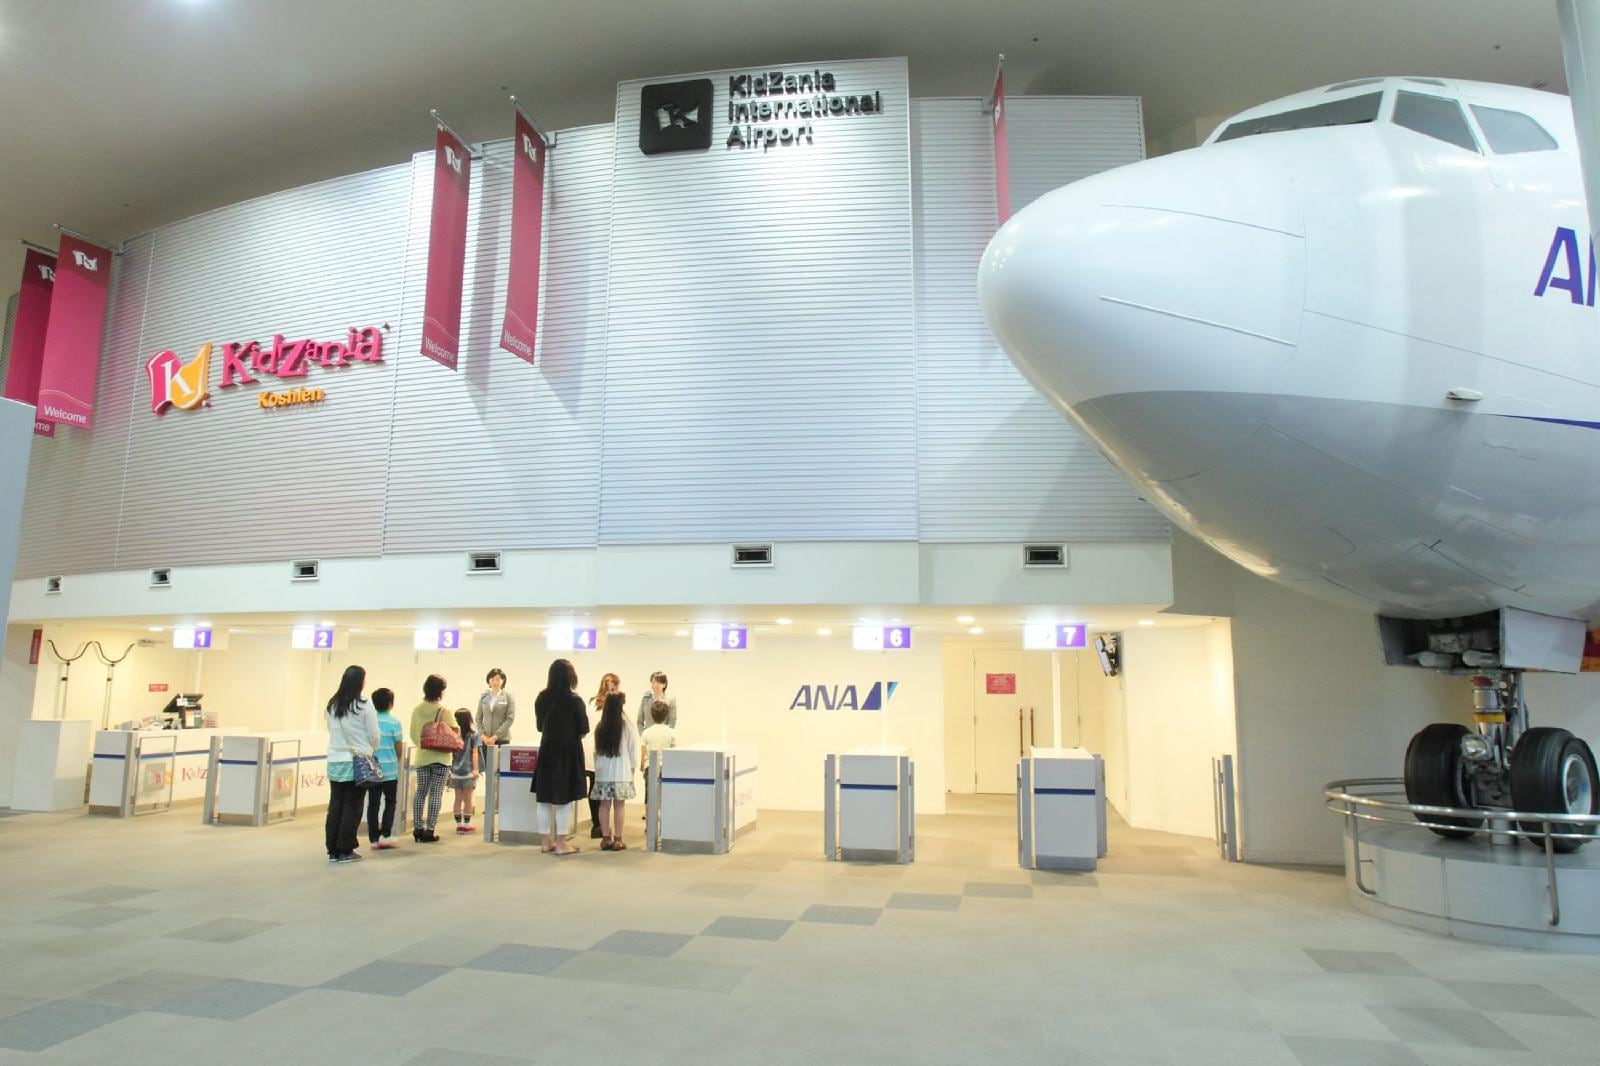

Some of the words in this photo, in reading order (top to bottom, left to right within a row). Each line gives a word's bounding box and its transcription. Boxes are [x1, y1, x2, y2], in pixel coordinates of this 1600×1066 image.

[728, 69, 835, 98] KidZania
[728, 90, 882, 123] International
[726, 123, 813, 152] Airport
[425, 336, 455, 363] Welcome
[504, 329, 532, 356] Welcome
[218, 326, 384, 388] KidZania
[257, 387, 326, 409] Koshien
[44, 405, 87, 424] Welcome
[198, 631, 206, 647] 1
[318, 631, 328, 647] 2
[442, 631, 453, 648] 3
[578, 631, 590, 648] 4
[727, 630, 740, 648] 5
[889, 628, 903, 647] 6
[1063, 626, 1077, 646] 7
[789, 685, 858, 710] ANA
[181, 767, 208, 781] KidZ
[301, 773, 327, 788] KidZ
